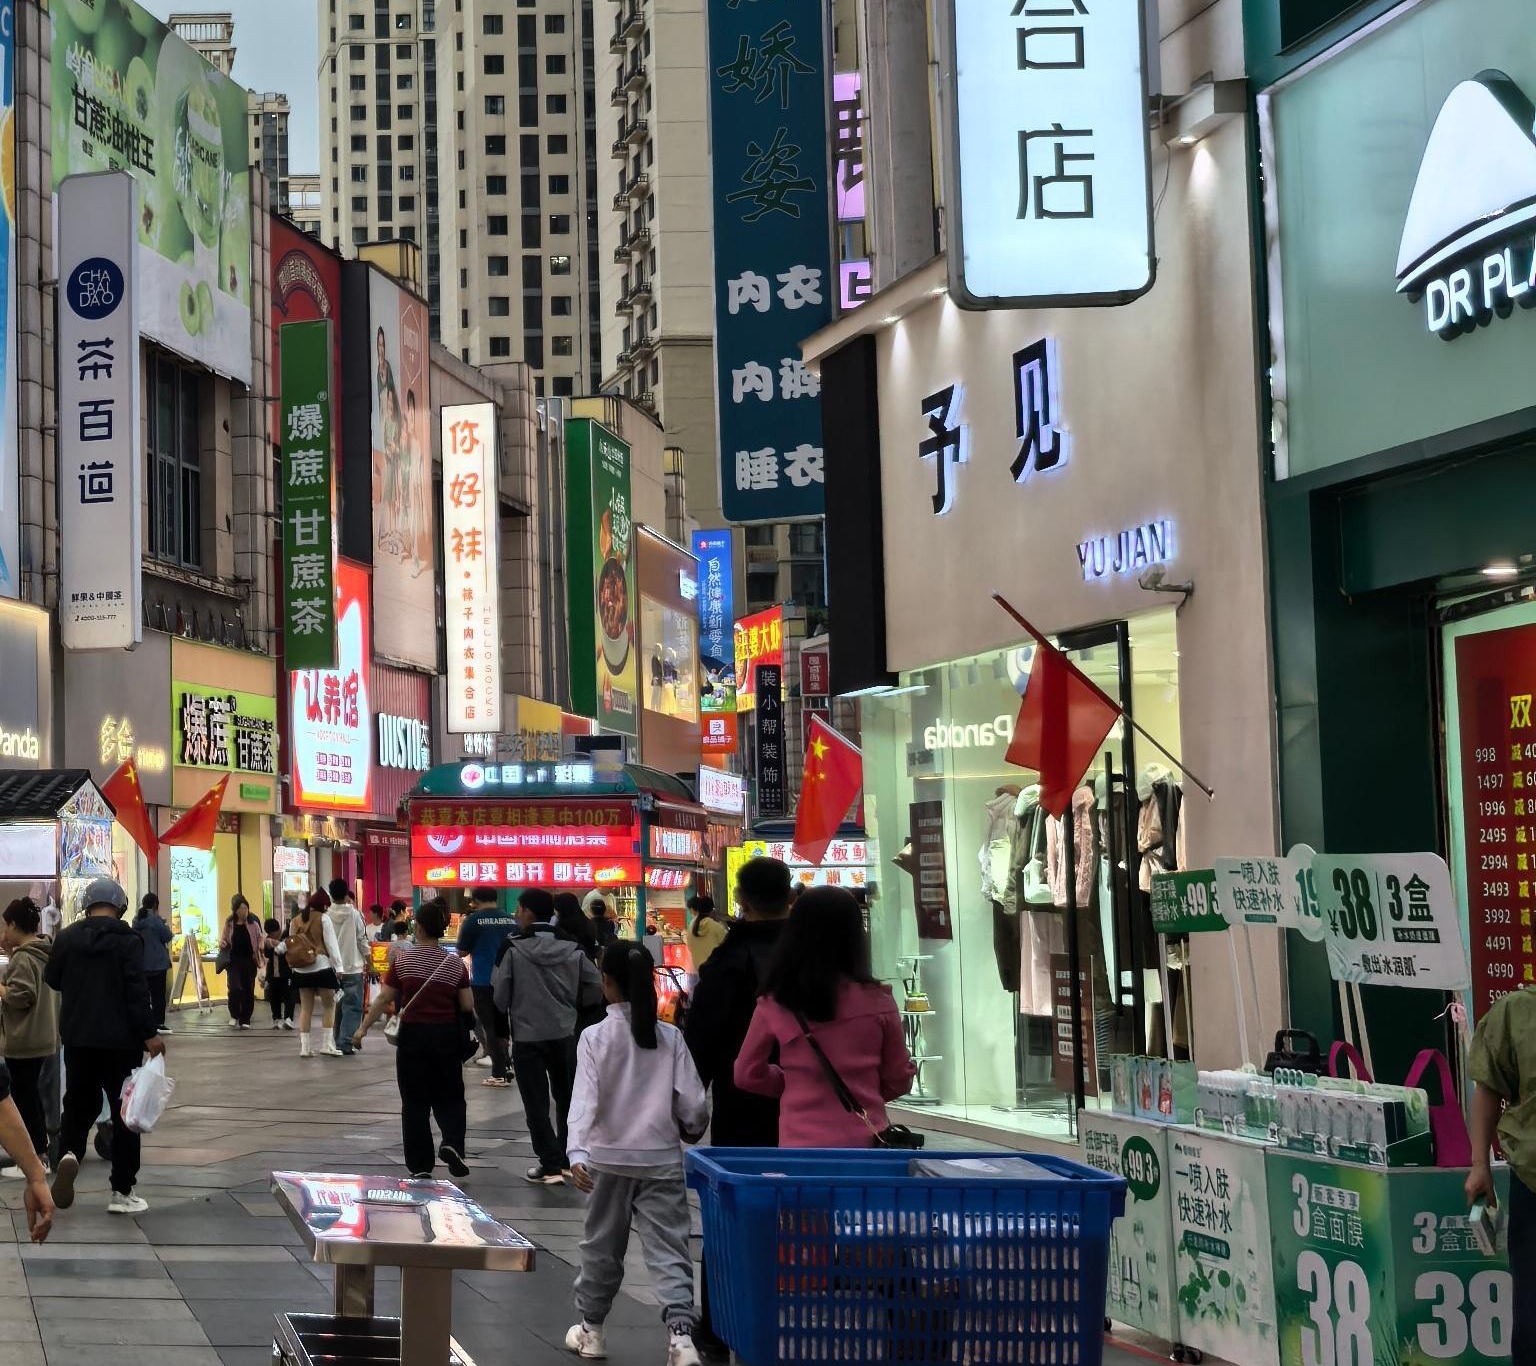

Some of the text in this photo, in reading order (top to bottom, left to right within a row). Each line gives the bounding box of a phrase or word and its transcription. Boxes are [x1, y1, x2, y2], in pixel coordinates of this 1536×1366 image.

[70, 81, 157, 178] 甘蔗油柑王
[78, 270, 111, 287] CHA
[79, 290, 115, 308] DAO
[726, 265, 823, 316] 内衣
[1426, 268, 1473, 332] DR
[731, 356, 822, 403] 内裤
[77, 337, 114, 503] 茶百道
[918, 337, 1069, 516] 予见
[286, 403, 325, 486] 爆蔗
[449, 419, 484, 562] 你好袜
[734, 445, 825, 493] 睡衣
[288, 509, 327, 636] 甘蔗茶
[462, 586, 477, 721] 袜子内衣集合店
[482, 605, 494, 718] HELLO SOCKS
[1510, 694, 1532, 729] 双
[1475, 747, 1496, 762] 998
[1477, 774, 1504, 790] 1497
[1479, 801, 1506, 817] 1996
[1479, 827, 1507, 843] 2495
[459, 862, 593, 882] 即买 即开 即兑
[1228, 861, 1281, 885] 一喷入肤
[1481, 854, 1508, 870] 2994
[1232, 886, 1285, 913] 快速补水
[1385, 872, 1435, 923] 3盒
[1483, 881, 1510, 897] 3493
[1484, 908, 1512, 925] 3992
[1485, 935, 1512, 952] 4491
[1487, 962, 1514, 979] 4990
[1175, 1162, 1231, 1202] 一喷入肤
[1177, 1190, 1233, 1234] 快速补水
[1291, 1172, 1310, 1237] 3
[1312, 1205, 1365, 1249] 盒面膜
[1412, 1211, 1438, 1255] 3
[1414, 1269, 1514, 1358] 38
